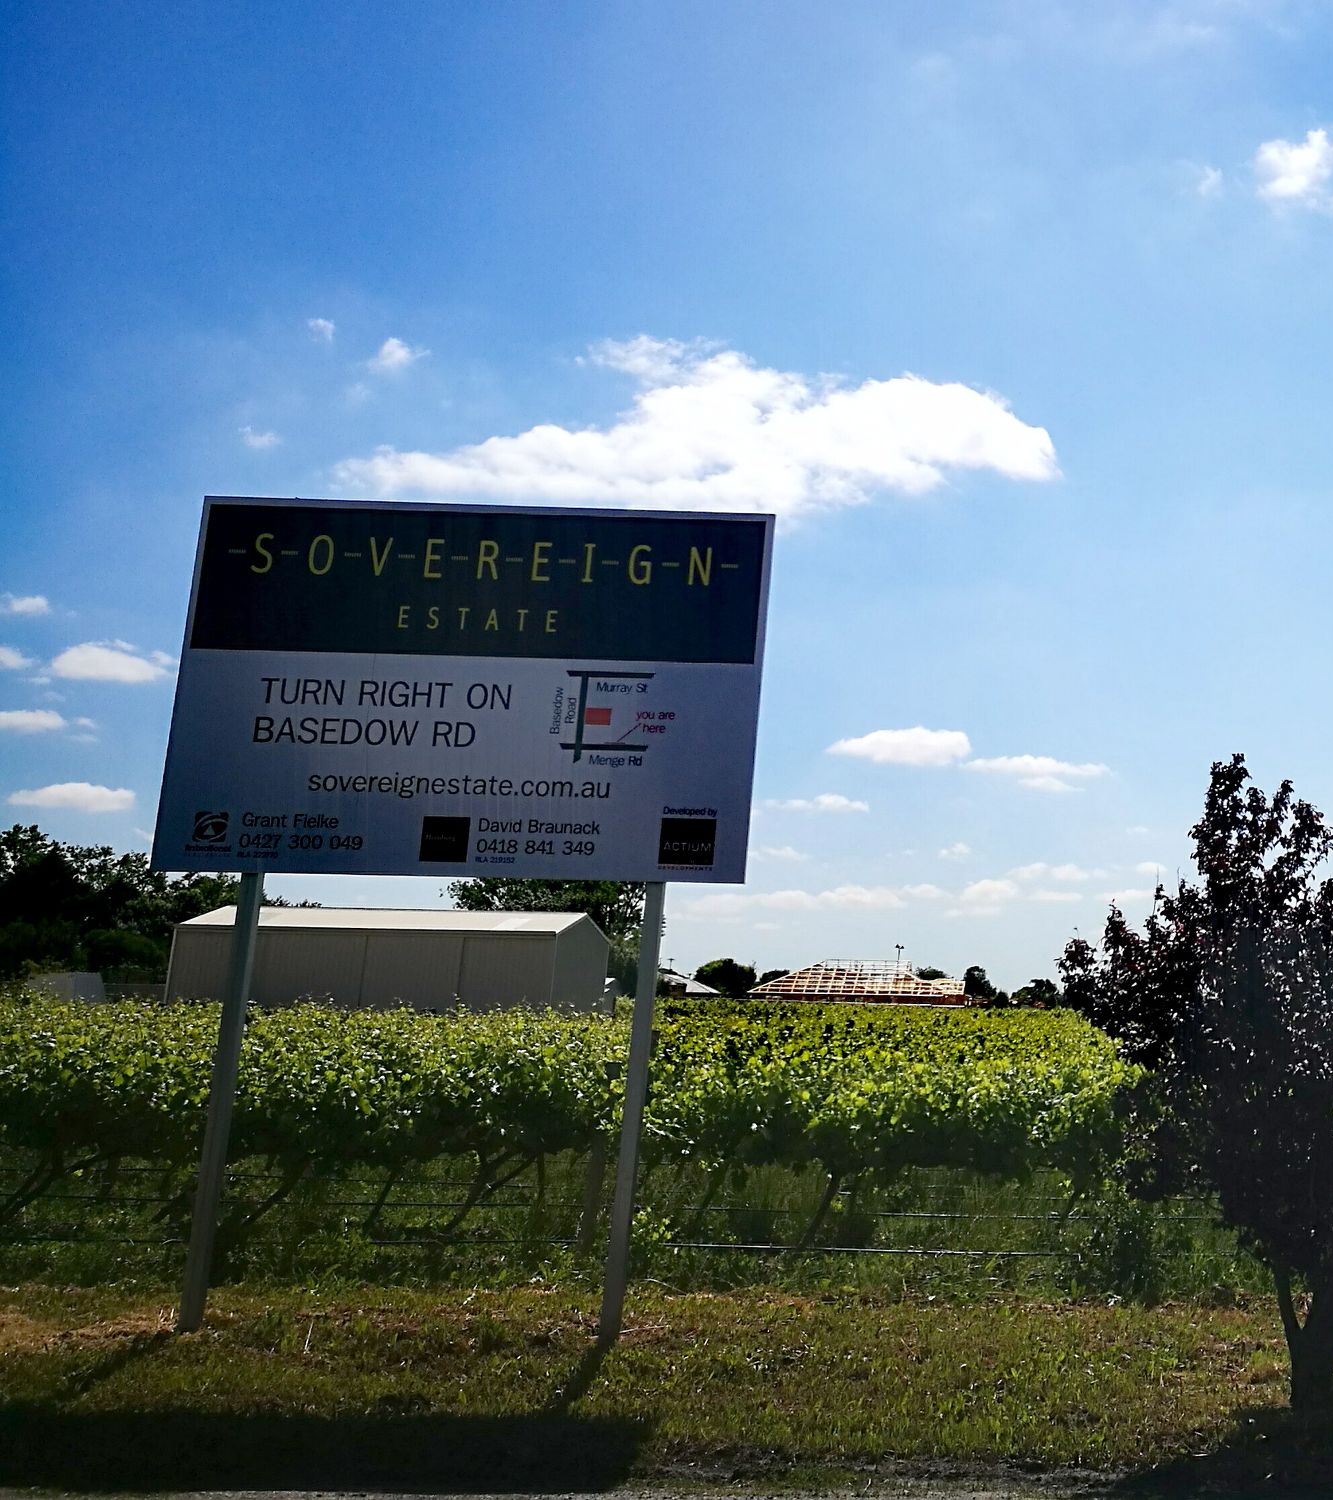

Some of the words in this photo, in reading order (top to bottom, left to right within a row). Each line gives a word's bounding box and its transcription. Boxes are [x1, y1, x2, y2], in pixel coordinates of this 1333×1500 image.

[398, 605, 558, 633] ESTATE
[261, 678, 346, 706] TURN
[358, 680, 453, 708] RIGHT
[466, 683, 512, 710] ON
[596, 682, 633, 695] Murray
[636, 683, 648, 693] St
[549, 687, 564, 735] Basedow
[565, 697, 577, 724] Road
[635, 711, 655, 721] you
[658, 711, 676, 720] are
[252, 716, 419, 746] BASEDOW
[432, 721, 476, 748] RD
[642, 724, 666, 733] here
[588, 755, 625, 767] Menge
[628, 756, 643, 766] Rd
[308, 772, 611, 799] sovereignestate.com.au
[663, 806, 706, 816] Developed
[708, 808, 718, 817] by
[242, 812, 287, 828] Grant
[293, 813, 339, 829] Fielke
[478, 817, 522, 834] David
[528, 819, 600, 835] Braunack
[239, 833, 282, 849] 0427
[288, 835, 323, 850] 300
[329, 836, 363, 851] 049
[476, 839, 518, 854] 0418
[525, 840, 555, 855] 841
[562, 841, 595, 856] 349
[663, 841, 711, 852] ACTIUM
